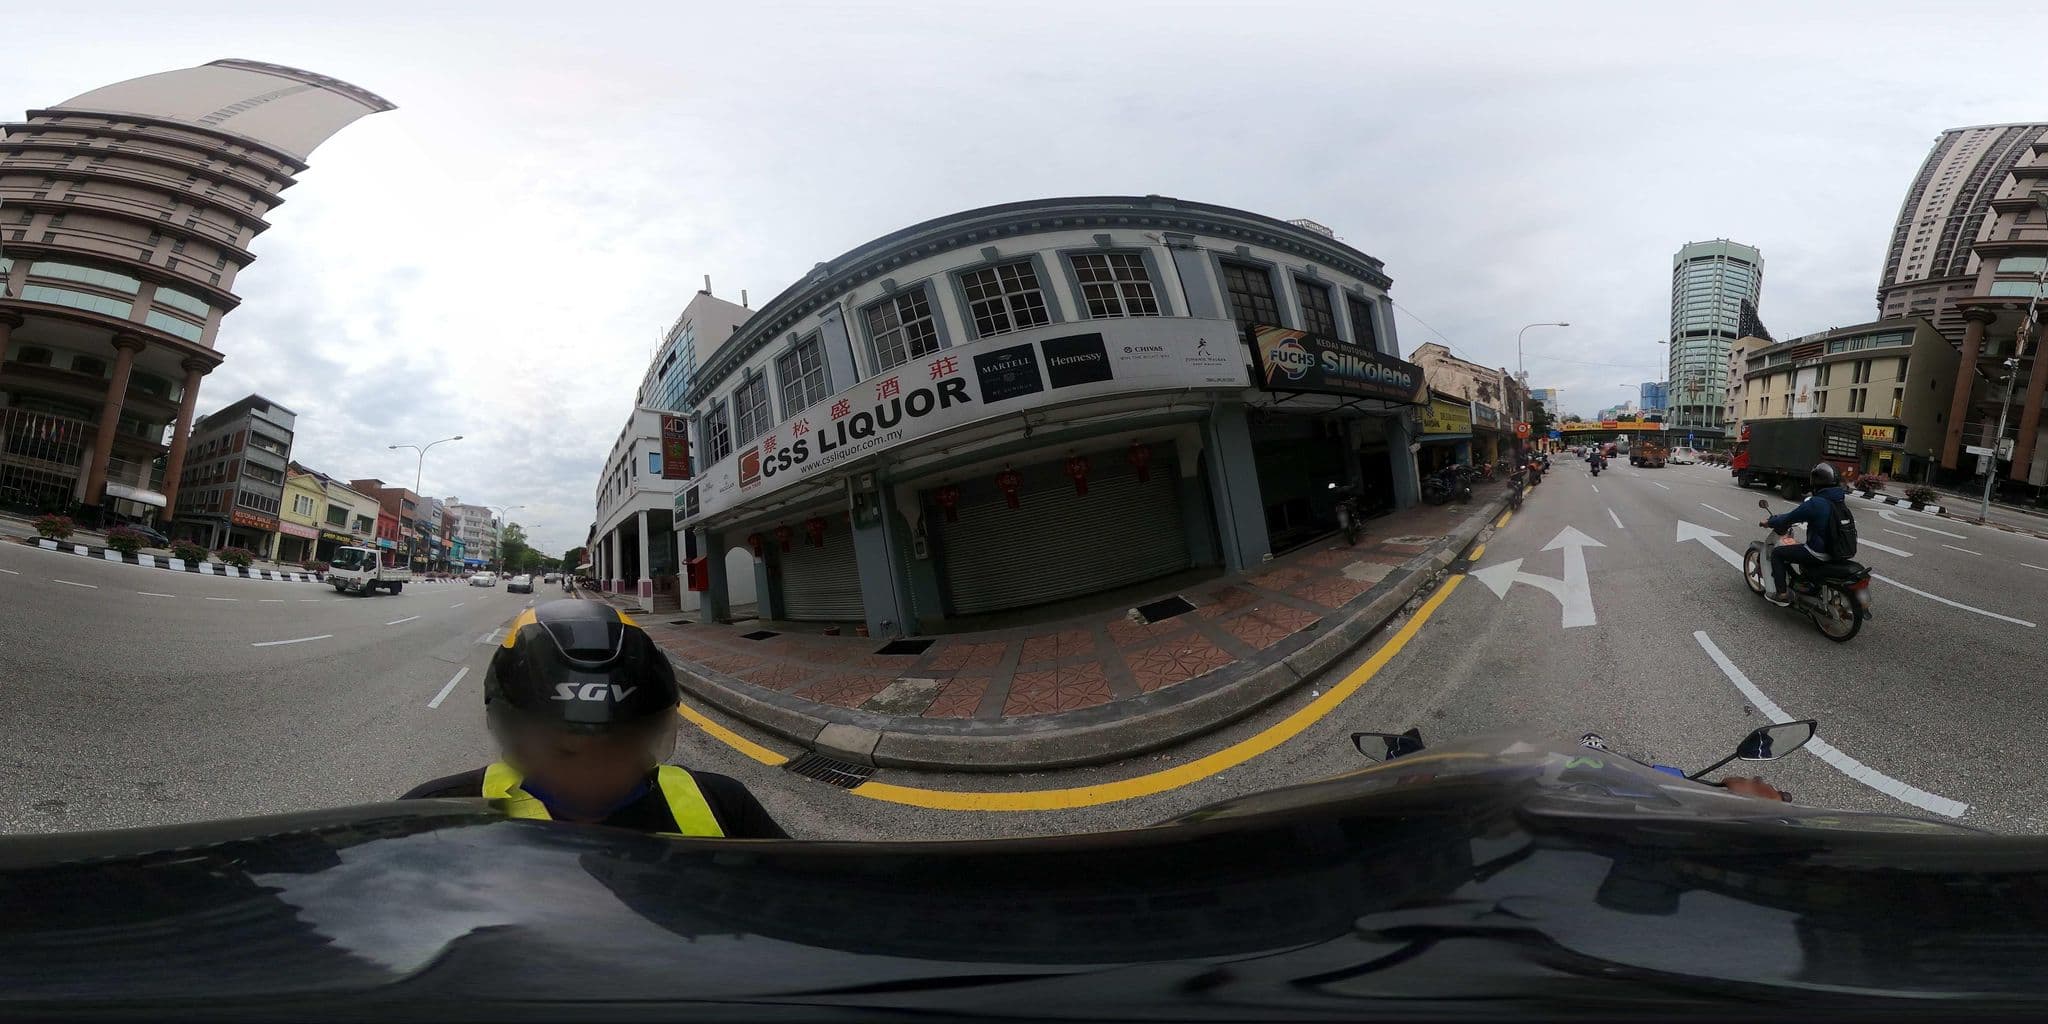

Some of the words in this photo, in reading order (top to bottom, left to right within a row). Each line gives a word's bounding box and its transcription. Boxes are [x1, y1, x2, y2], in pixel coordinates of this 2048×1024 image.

[1315, 337, 1340, 351] KEDAI
[981, 357, 1032, 374] MARTELL
[1050, 352, 1102, 367] Hennessy
[1269, 349, 1316, 367] FUCHS
[1320, 350, 1412, 388] Silkolene
[664, 418, 686, 433] 4D
[762, 438, 810, 478] CSS
[818, 376, 973, 454] LIQUOR
[800, 429, 903, 474] www.cssliquor.com.my
[550, 682, 639, 703] SGV
